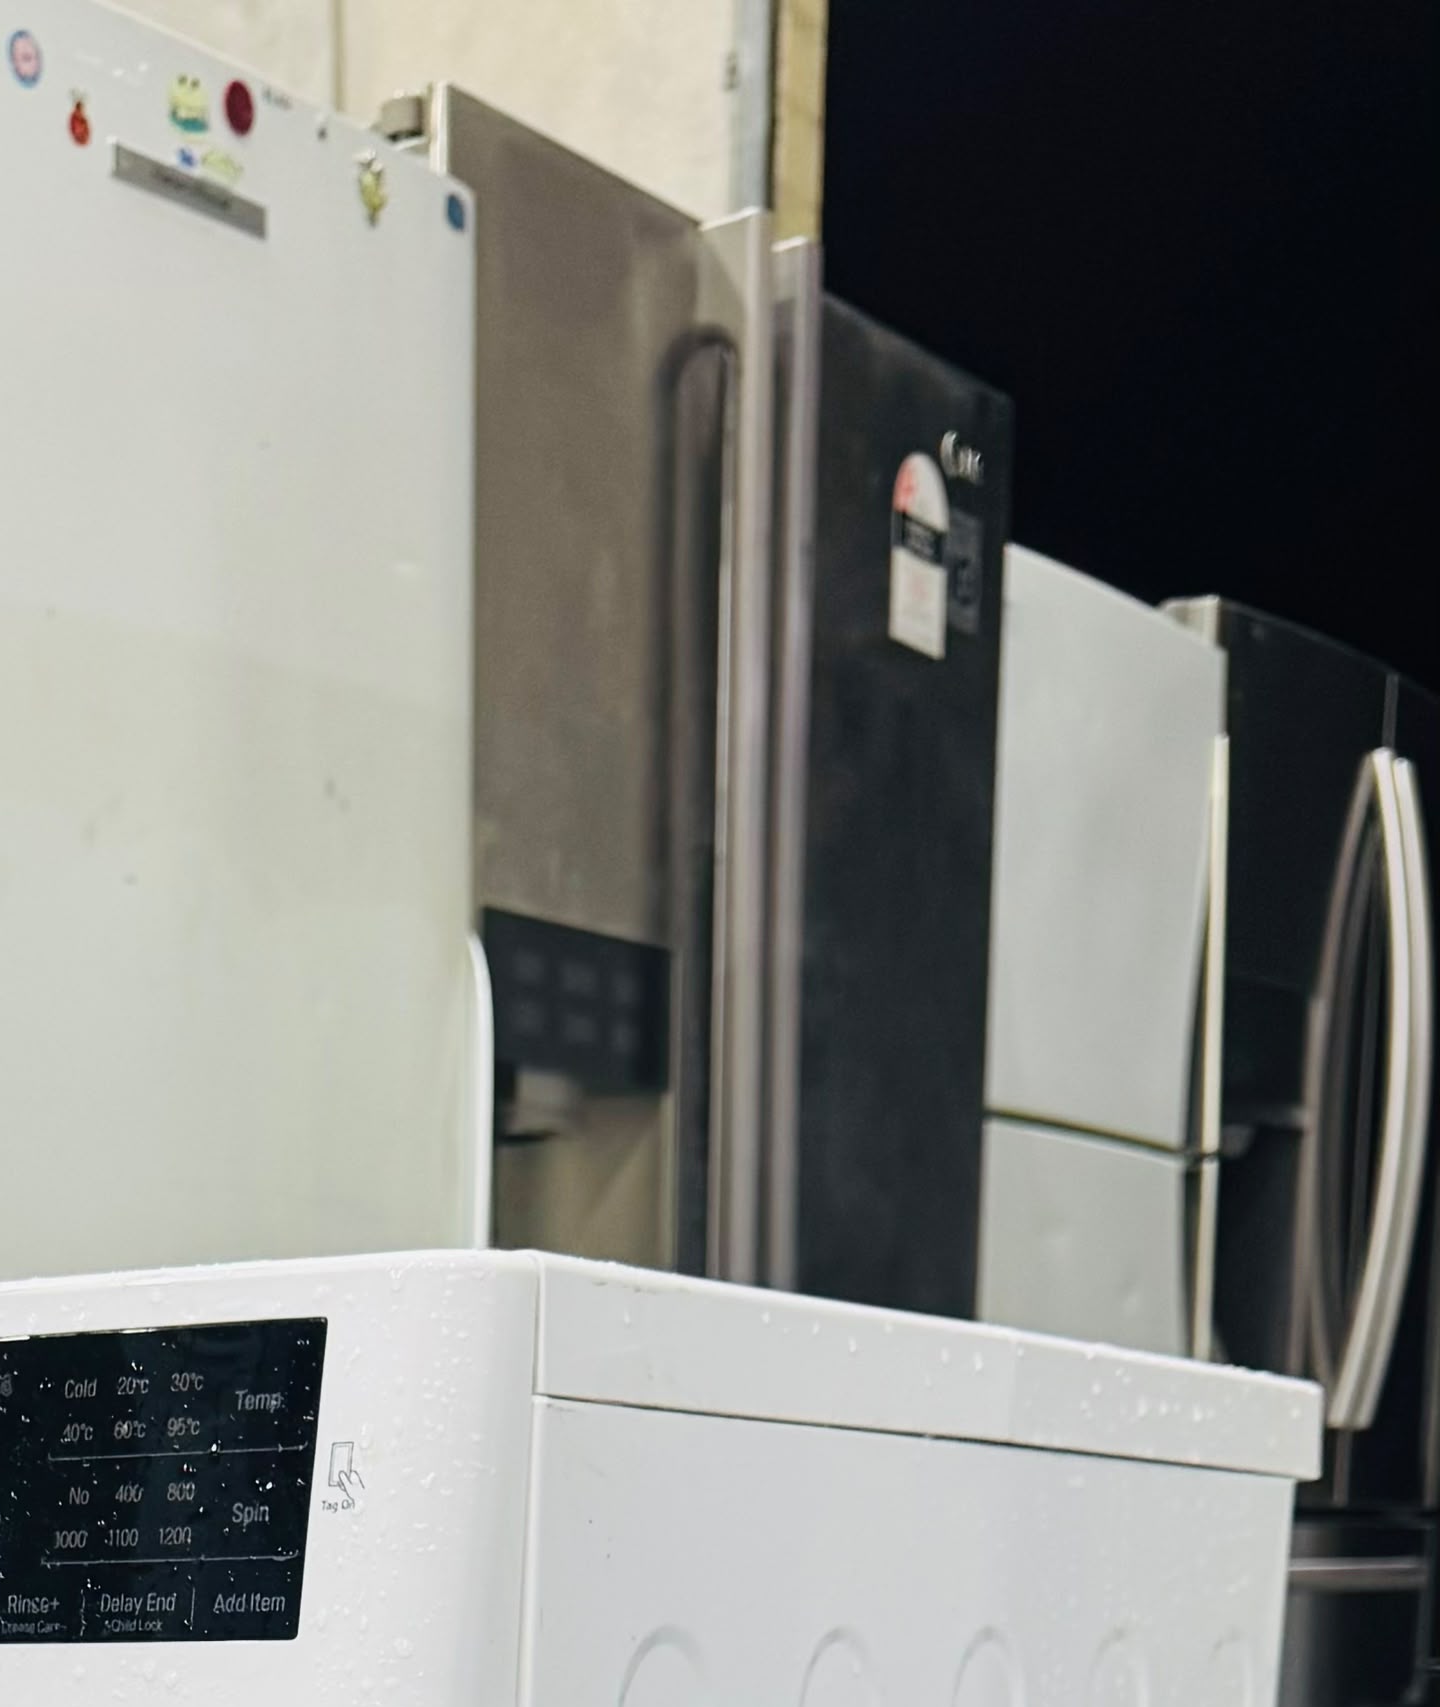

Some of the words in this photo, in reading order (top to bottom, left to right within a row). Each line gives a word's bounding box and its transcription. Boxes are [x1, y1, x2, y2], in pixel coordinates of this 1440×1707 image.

[64, 1378, 98, 1399] Cold
[68, 1486, 90, 1506] No
[115, 1483, 144, 1503] 400
[166, 1482, 196, 1501] 800
[231, 1502, 270, 1526] Spin
[321, 1499, 339, 1514] Tag
[341, 1498, 356, 1511] On
[55, 1530, 89, 1549] 1000
[109, 1528, 139, 1548] 1100
[160, 1527, 192, 1546] 1200
[7, 1594, 61, 1615] Rinse+
[101, 1593, 142, 1615] Delay
[146, 1592, 176, 1612] End
[213, 1593, 246, 1613] Add
[249, 1593, 286, 1613] Item
[111, 1620, 137, 1632] Child
[138, 1620, 163, 1632] Lock
